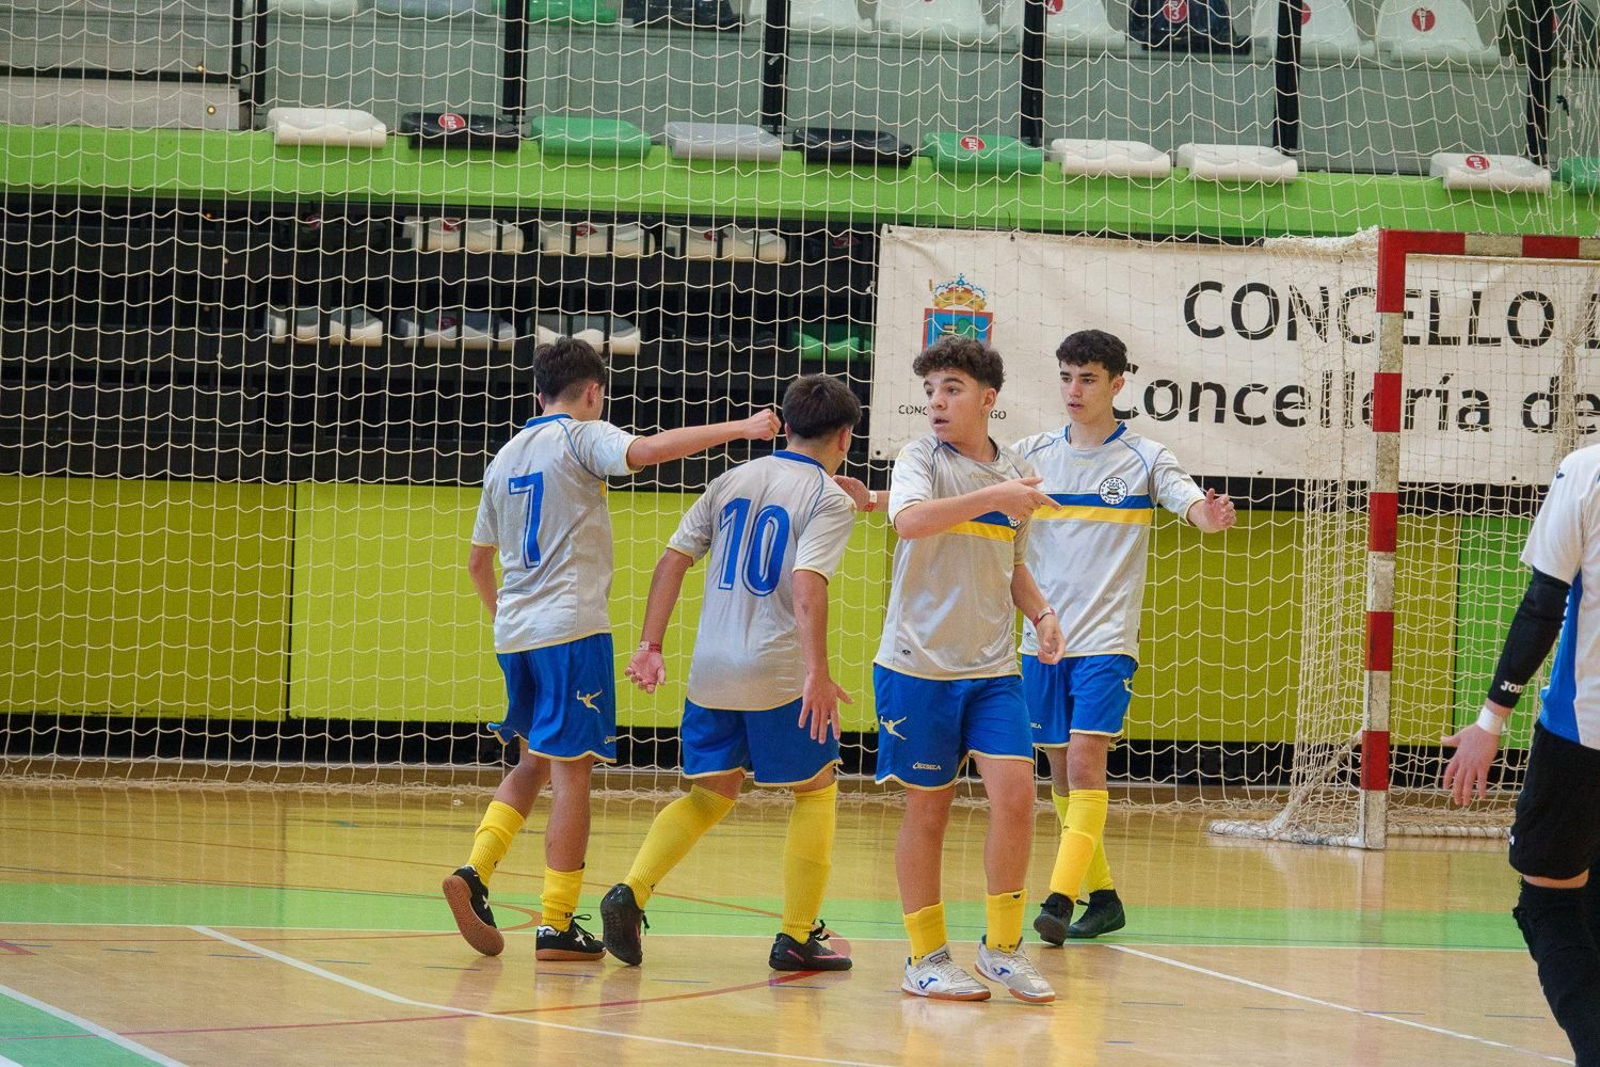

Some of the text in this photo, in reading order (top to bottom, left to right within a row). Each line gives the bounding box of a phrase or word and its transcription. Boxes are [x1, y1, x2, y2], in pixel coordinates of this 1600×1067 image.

[1183, 280, 1554, 348] CONCELLO
[898, 404, 1007, 420] CONC GO
[508, 471, 544, 569] 7
[717, 497, 790, 597] 10
